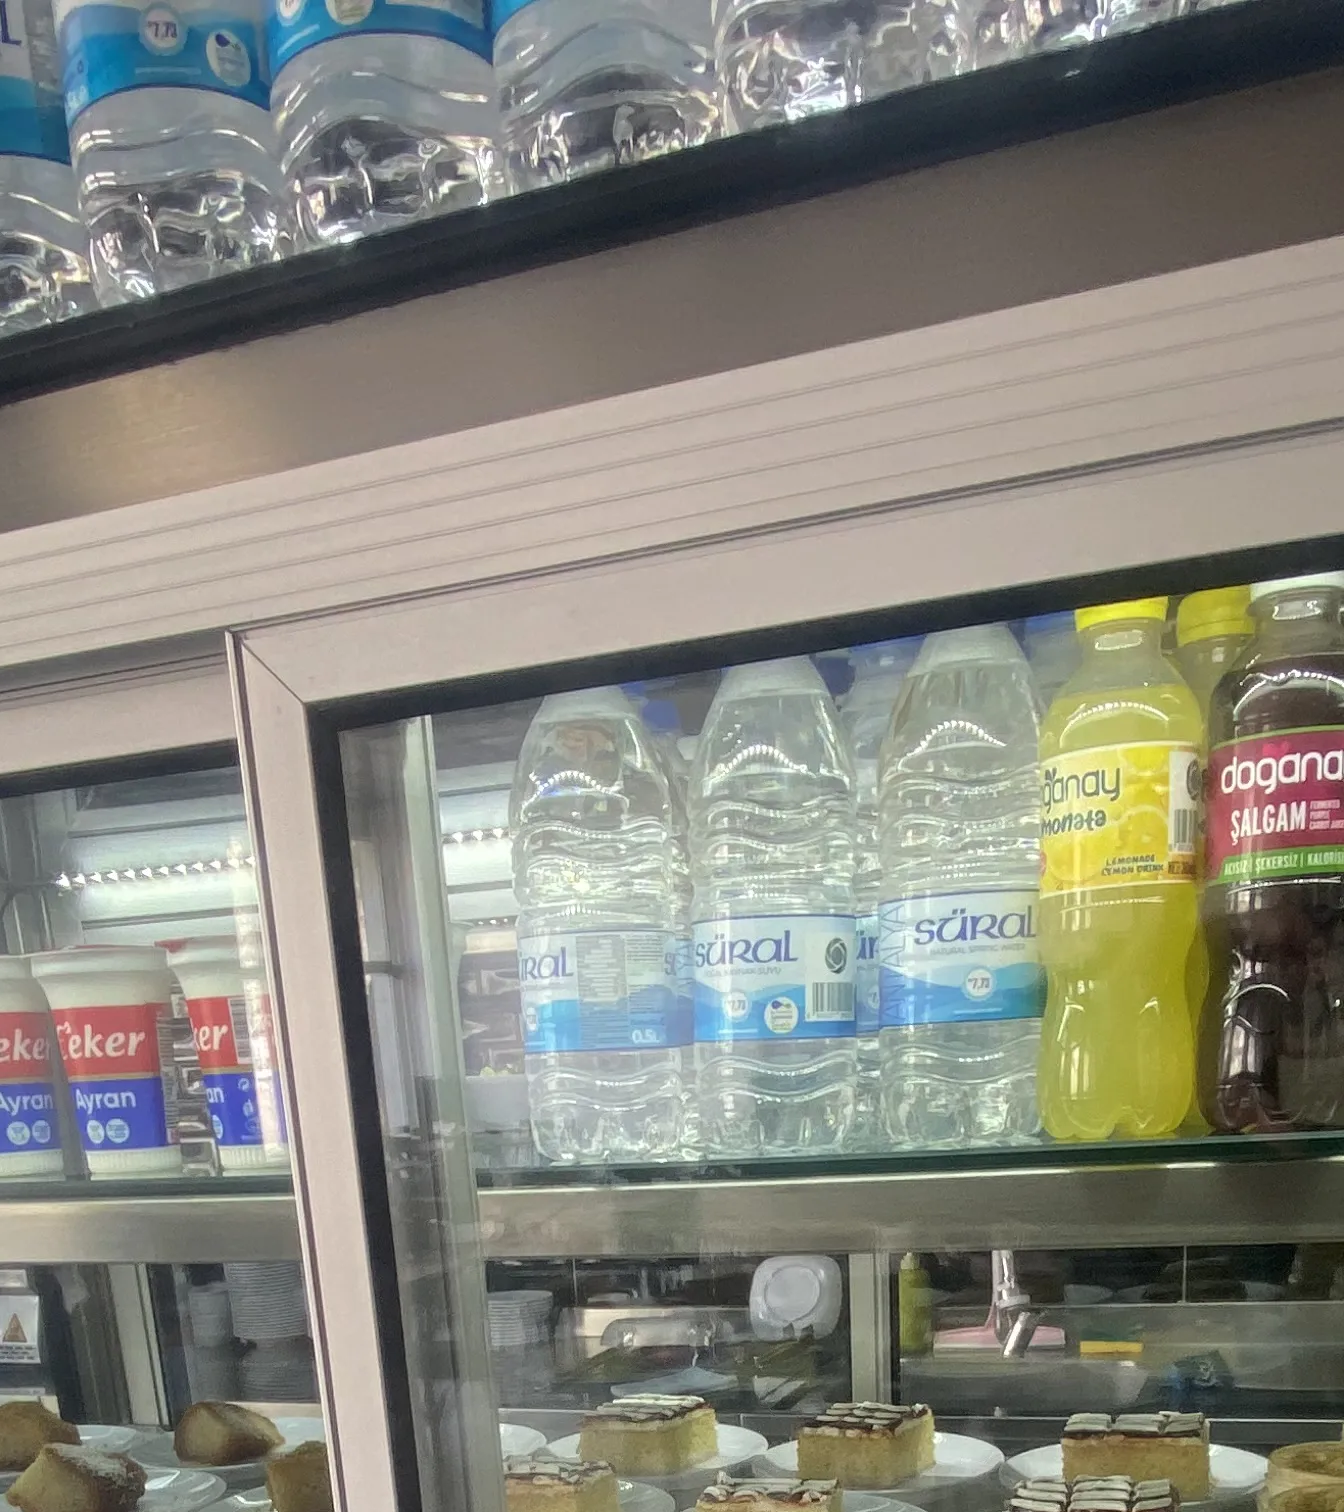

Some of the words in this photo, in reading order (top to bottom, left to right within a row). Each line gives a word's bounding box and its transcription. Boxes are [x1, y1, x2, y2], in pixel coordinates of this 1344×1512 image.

[1040, 809, 1107, 836] monata
[1230, 800, 1307, 846] ŞALGAM
[75, 1088, 137, 1115] Ayran
